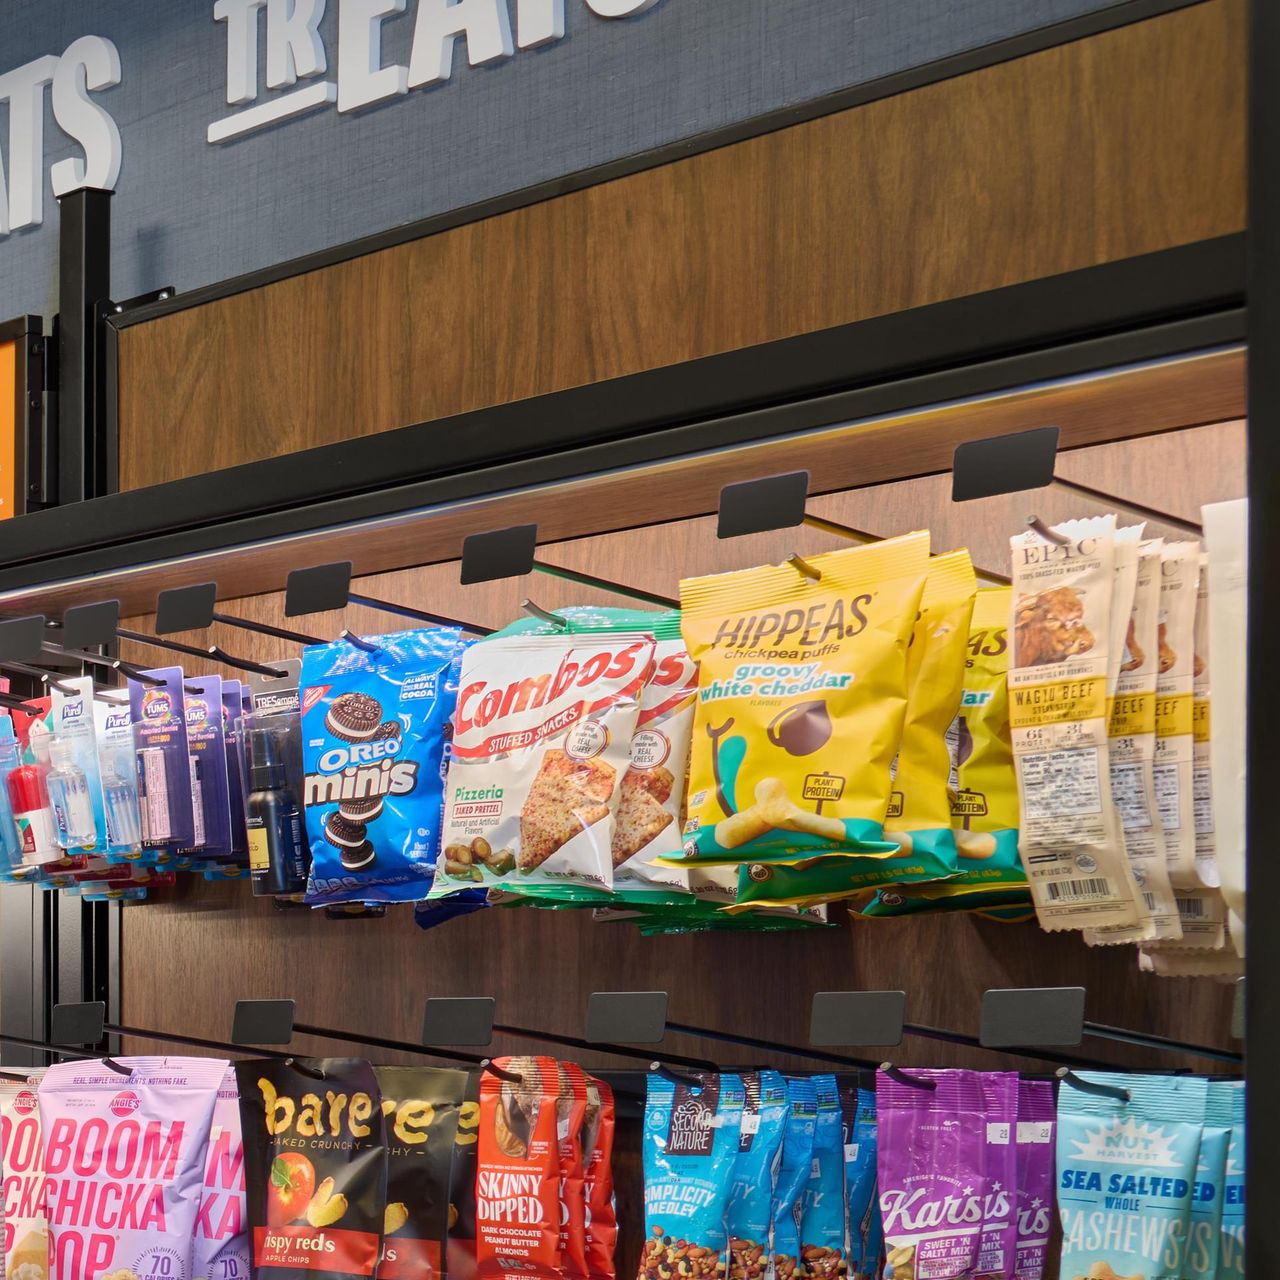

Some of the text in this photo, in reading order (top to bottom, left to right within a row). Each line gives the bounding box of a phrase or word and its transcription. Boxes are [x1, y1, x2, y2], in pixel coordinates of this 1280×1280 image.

[1021, 538, 1098, 566] EPIC
[711, 593, 873, 649] HIPPEAS
[724, 643, 840, 661] chickpea puffs
[736, 663, 817, 681] groovy
[457, 643, 644, 735] Combos
[701, 673, 852, 702] white cheddar
[1014, 682, 1094, 707] WAGYU BEEF
[488, 707, 579, 753] STUFFED SNACKS
[321, 739, 400, 770] OREO
[306, 762, 416, 803] minis
[455, 786, 504, 801] Pizzeria
[257, 1077, 372, 1138] bare
[45, 1118, 185, 1180] BOOM
[670, 1130, 709, 1150] NATURE
[1106, 1133, 1154, 1149] NUT
[1096, 1149, 1159, 1160] HARVEST
[478, 1171, 543, 1197] SKINNY
[1061, 1169, 1189, 1198] SEA SALTED
[477, 1197, 543, 1224] DIPPED
[648, 1202, 698, 1217] MEDLEY
[1105, 1196, 1140, 1211] WHOLE
[295, 1232, 336, 1253] reds
[481, 1226, 542, 1237] DARK CHOCOLATE
